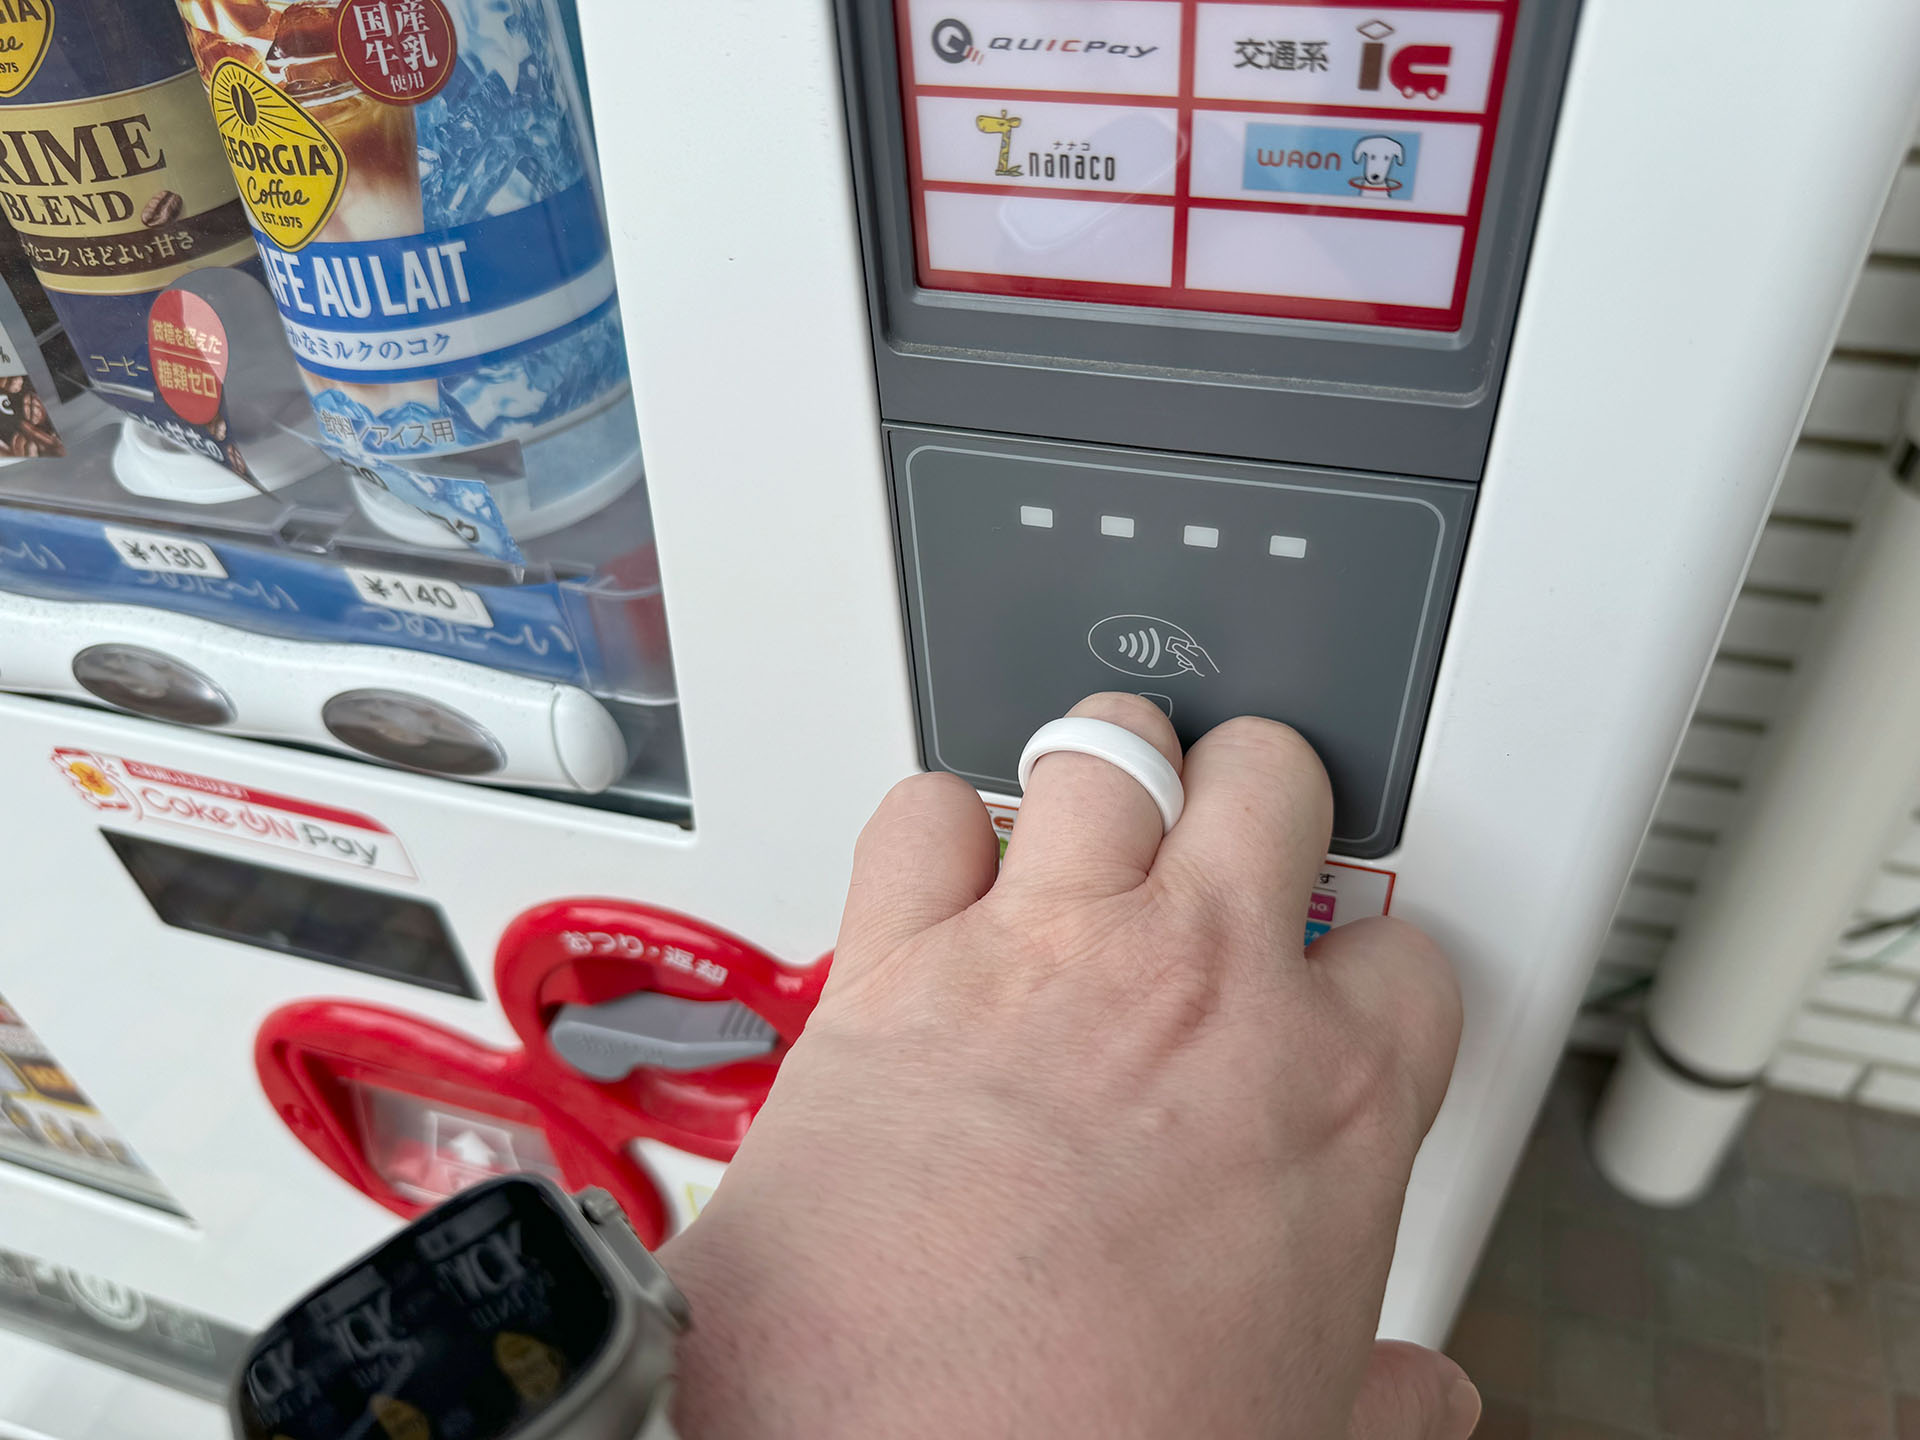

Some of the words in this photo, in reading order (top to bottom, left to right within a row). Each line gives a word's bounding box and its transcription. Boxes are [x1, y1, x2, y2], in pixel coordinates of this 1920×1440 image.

[353, 0, 431, 40] 国産
[365, 33, 438, 76] 牛乳
[988, 36, 1159, 59] QUICPay
[1233, 38, 1330, 73] 交通系
[390, 71, 425, 93] 使用
[221, 132, 334, 176] GEORGIA
[1052, 139, 1091, 152] ナナコ
[1256, 148, 1342, 172] WAON
[1028, 151, 1116, 182] nanaco
[2, 190, 135, 226] BLEND
[247, 176, 310, 209] Coffee
[312, 255, 372, 319] AU
[368, 240, 471, 317] LAIT
[90, 355, 149, 377] コーヒー
[157, 358, 218, 399] 糖類ゼロ
[122, 538, 208, 570] ¥130
[362, 573, 458, 610] ¥140
[140, 786, 237, 830] Coke
[300, 821, 379, 867] Pay
